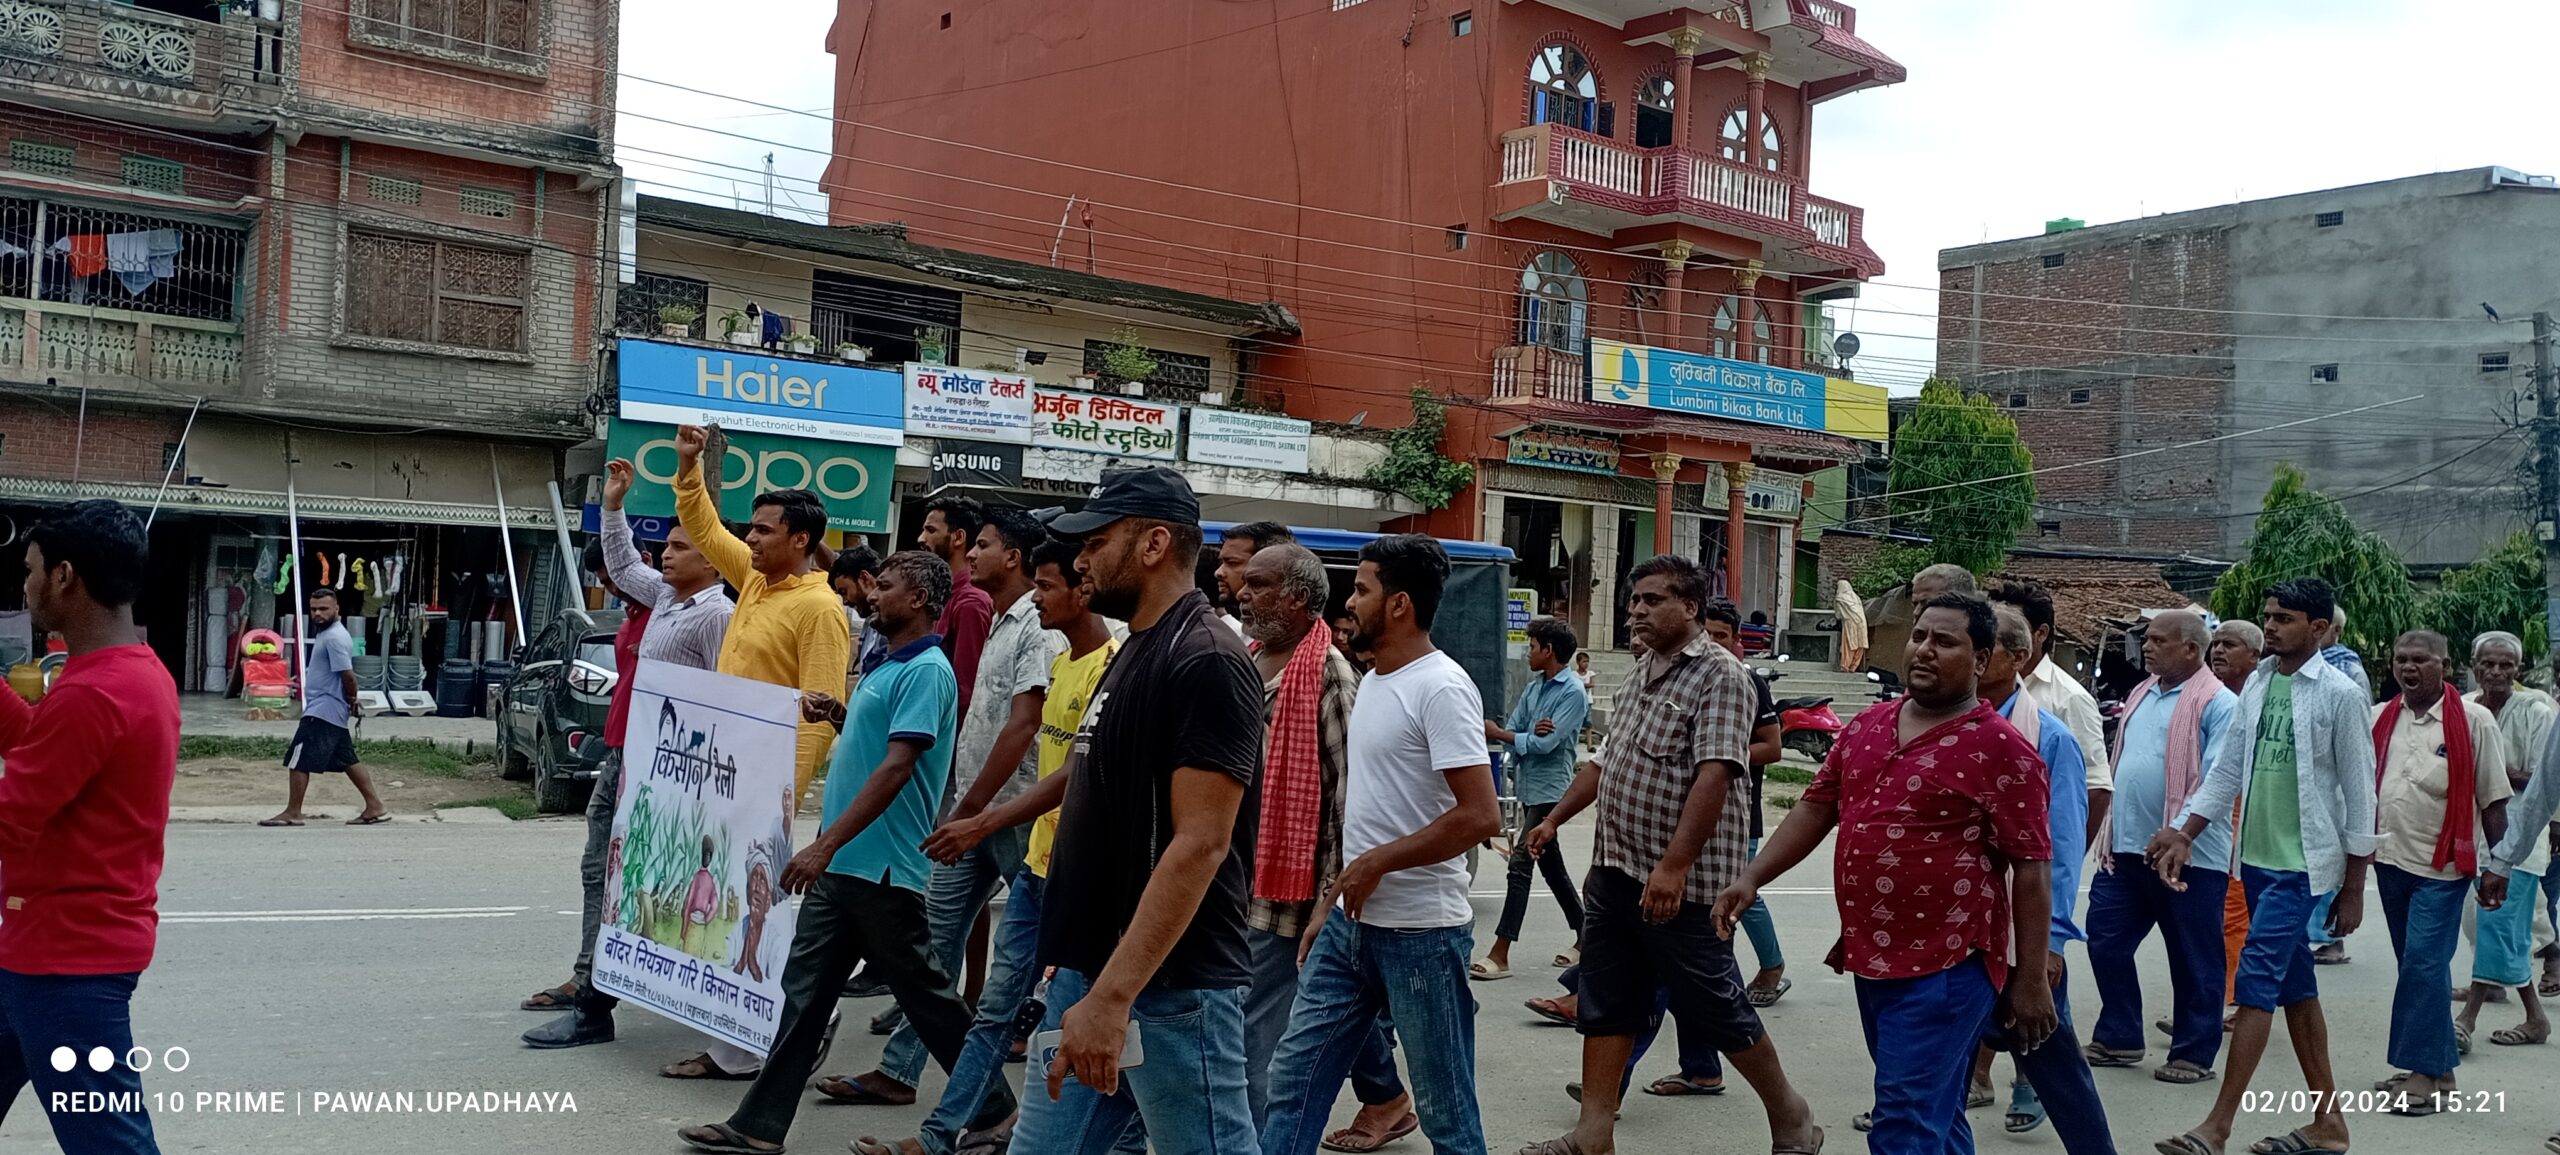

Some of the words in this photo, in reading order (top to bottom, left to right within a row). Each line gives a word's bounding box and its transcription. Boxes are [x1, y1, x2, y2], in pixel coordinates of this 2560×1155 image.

[697, 356, 829, 409] Haier
[917, 373, 940, 396] न्यू
[940, 373, 986, 395] मोडेल
[989, 377, 1026, 399] टेलर्स
[1721, 367, 1761, 392] विकास
[1765, 372, 1787, 395] बैंक
[1088, 397, 1165, 425] डिजिटल
[1669, 389, 1717, 412] Lumbini
[1722, 397, 1752, 417] Bikas
[1756, 402, 1784, 422] Bank
[1787, 406, 1807, 425] Ltd.
[745, 417, 796, 432] Electronic
[797, 424, 818, 434] Hub
[1051, 418, 1101, 441] फोटो
[851, 518, 876, 528] MOBILE
[713, 746, 737, 800] रैली
[605, 931, 632, 965] बाँदर
[633, 940, 677, 982] नियंत्रण
[678, 959, 699, 991] गरि
[700, 964, 740, 1008] किसान
[743, 988, 775, 1022] बचाउ
